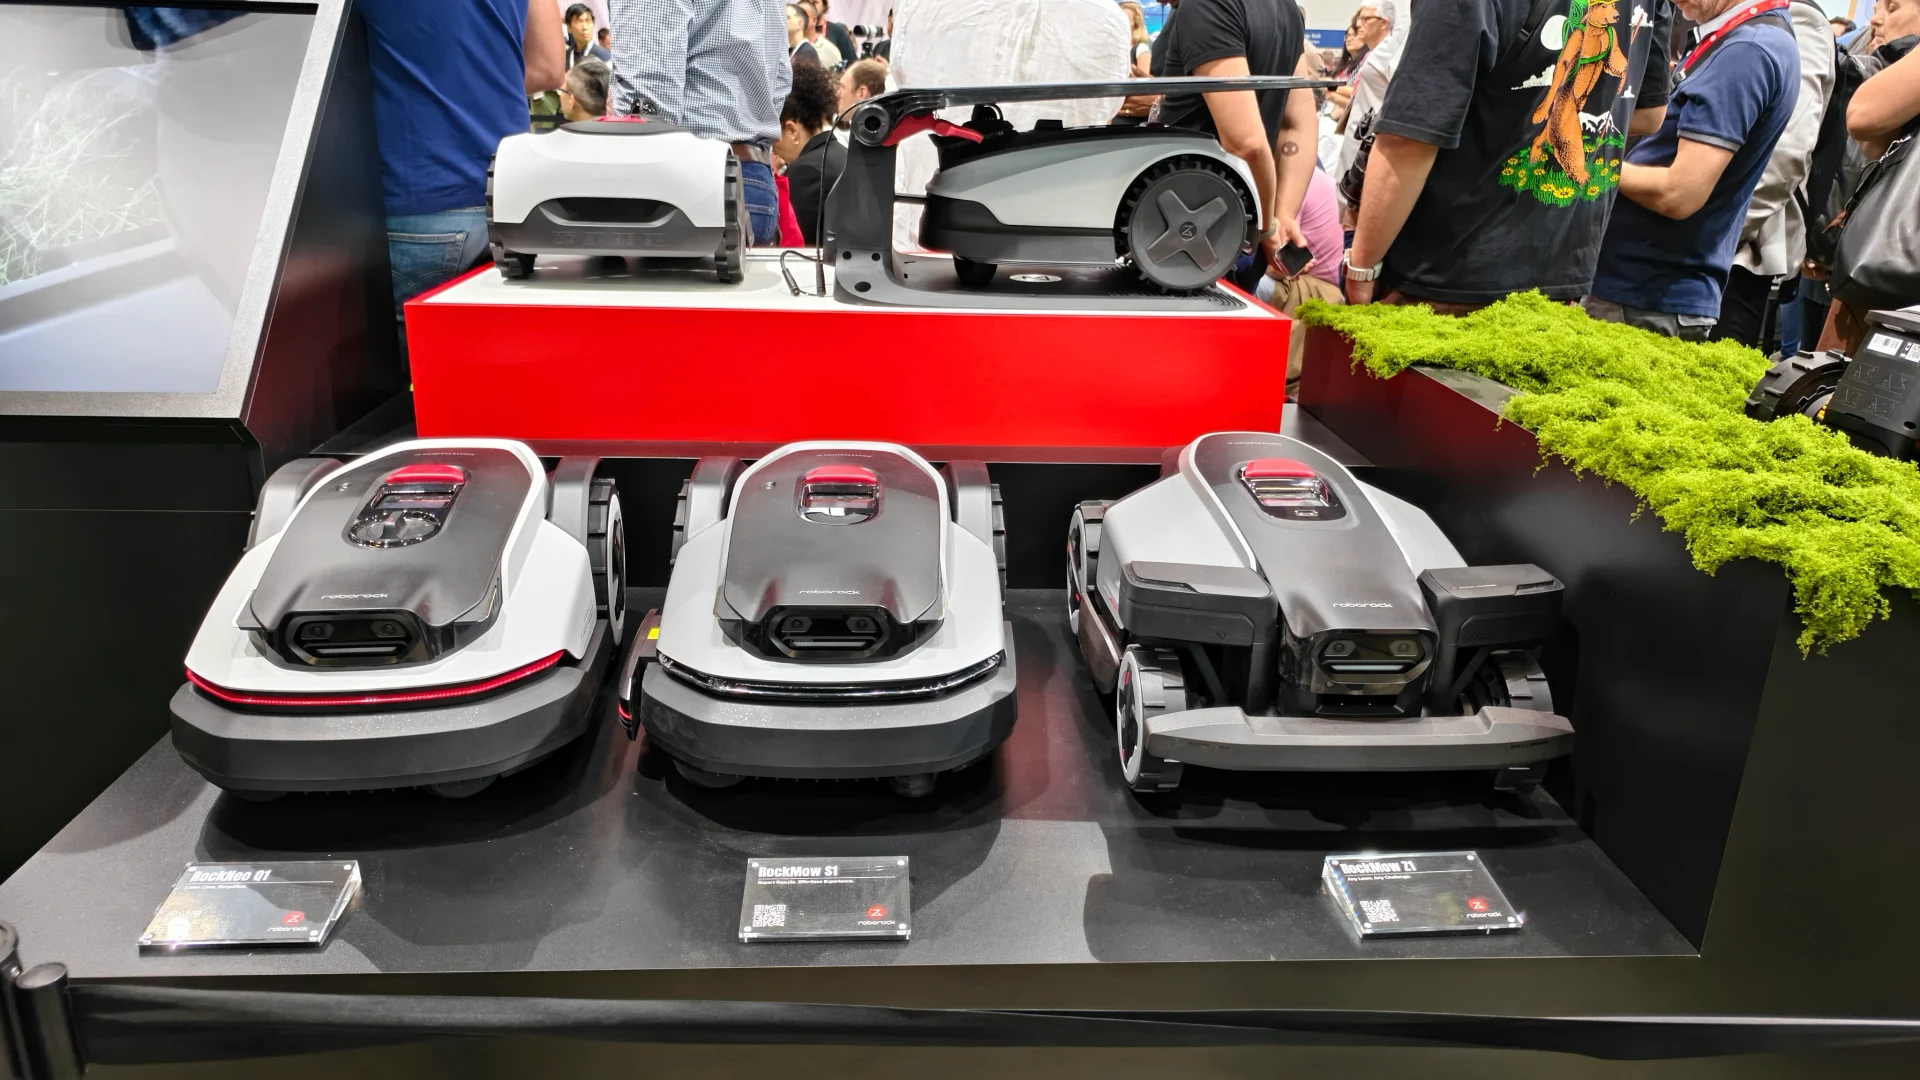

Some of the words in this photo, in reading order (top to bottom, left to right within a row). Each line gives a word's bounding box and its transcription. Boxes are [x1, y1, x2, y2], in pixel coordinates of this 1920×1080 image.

[758, 866, 821, 878] RockMow
[824, 865, 838, 876] S1
[1339, 862, 1401, 874] RockMow
[1400, 860, 1417, 872] Z1
[190, 871, 252, 882] RockNeo
[253, 870, 272, 882] Q1
